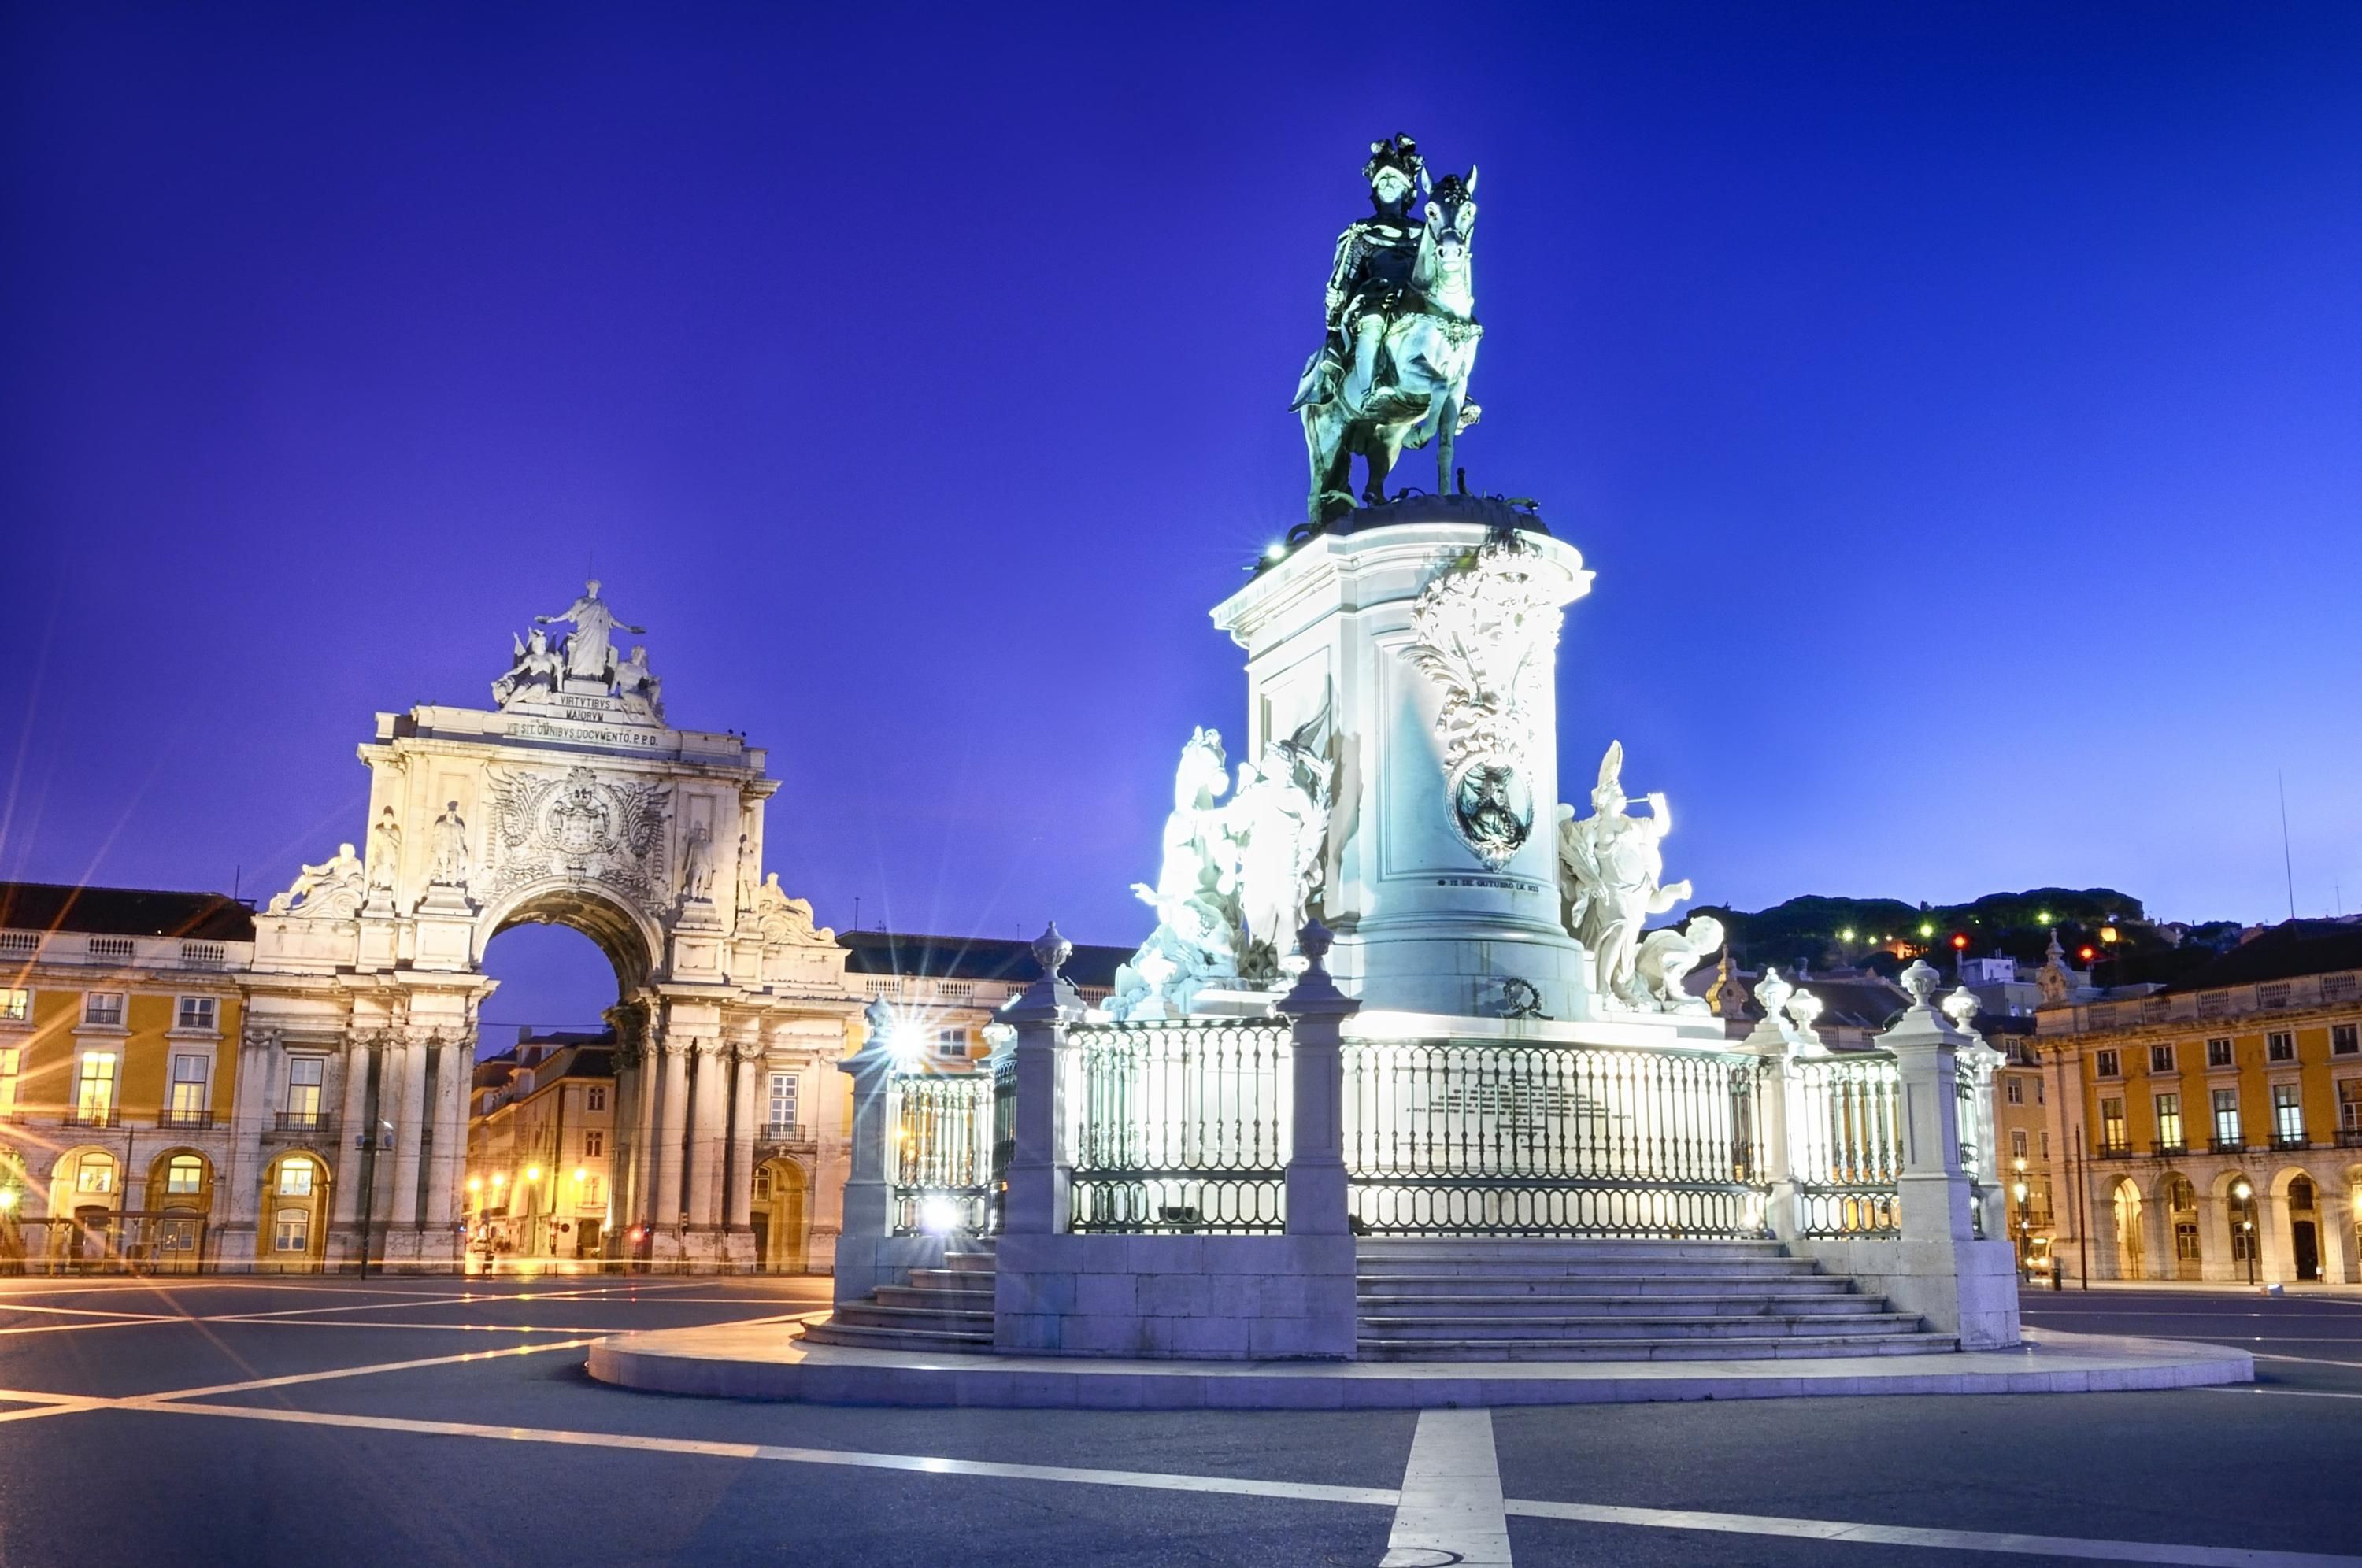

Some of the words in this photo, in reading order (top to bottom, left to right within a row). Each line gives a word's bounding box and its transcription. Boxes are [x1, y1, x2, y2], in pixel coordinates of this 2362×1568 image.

[561, 695, 610, 708] VIRTVTIBVS
[567, 709, 603, 722] MAIORVM
[537, 725, 574, 738] OMNIBVS
[1476, 880, 1513, 889] OUTUBRO
